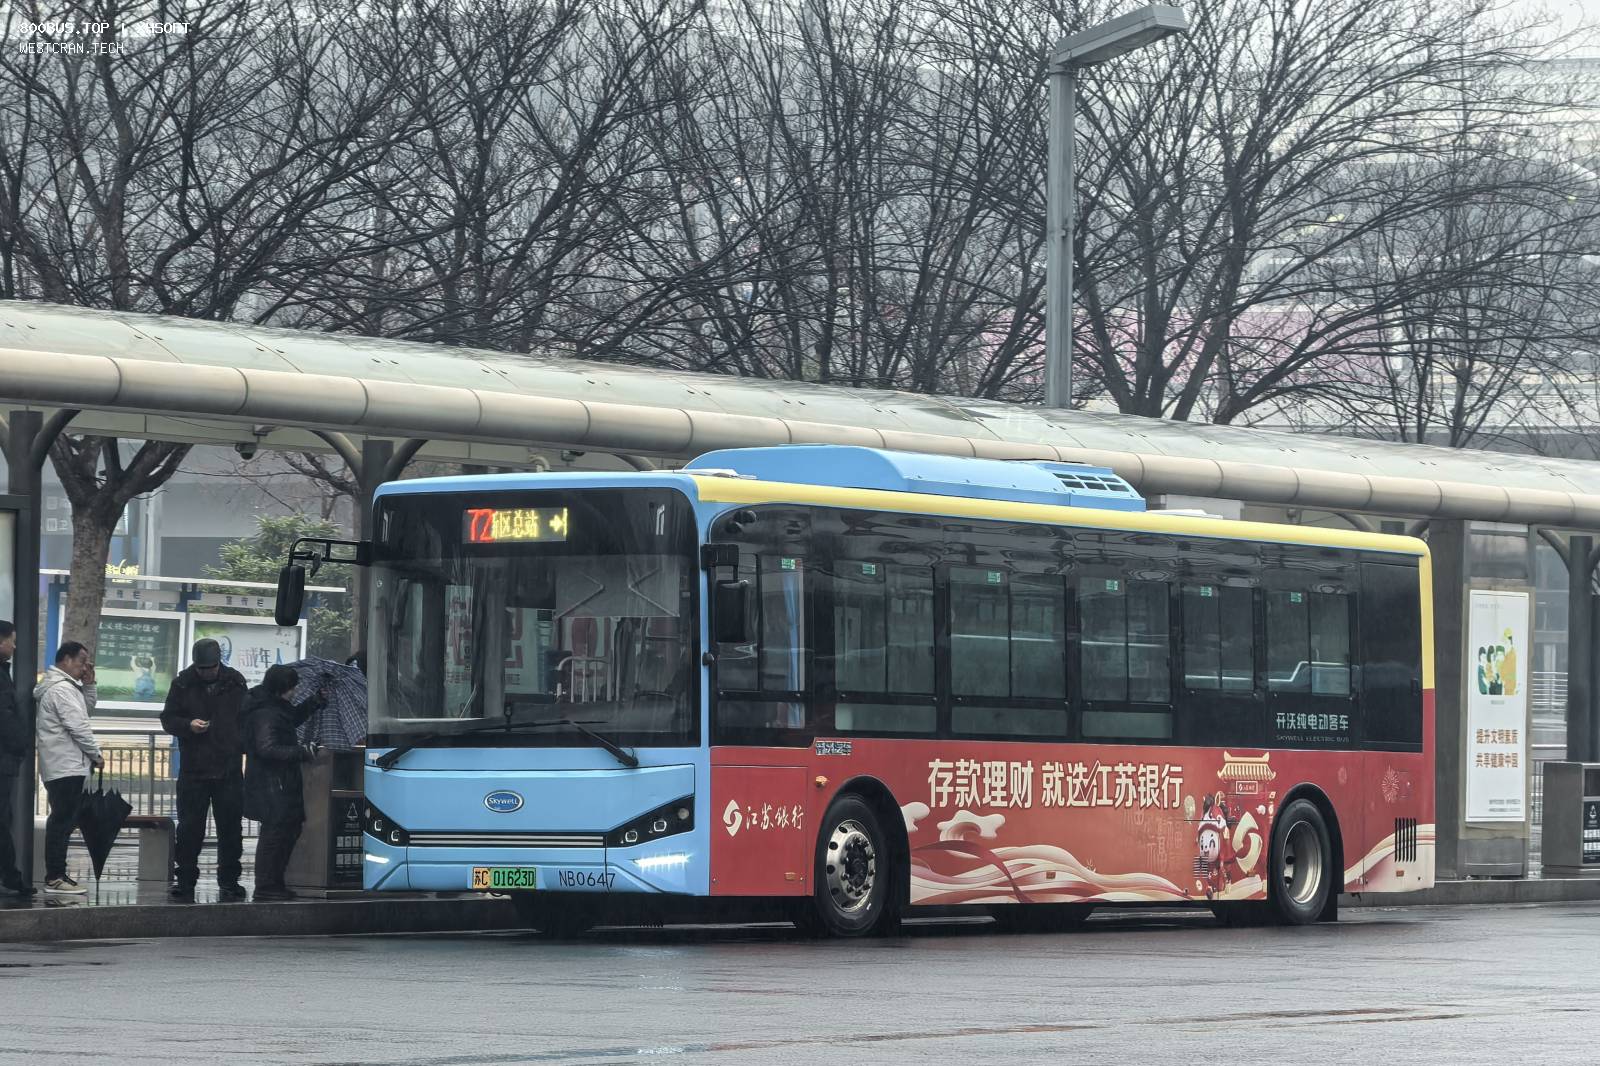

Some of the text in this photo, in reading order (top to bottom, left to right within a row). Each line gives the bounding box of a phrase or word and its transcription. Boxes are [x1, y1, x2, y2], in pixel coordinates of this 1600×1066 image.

[467, 508, 496, 542] 72
[1276, 712, 1349, 731] 开沃纯电动客车
[928, 758, 1184, 809] 存款理财 就选江苏银行
[745, 802, 804, 830] 江苏银行
[558, 869, 616, 888] NB0647
